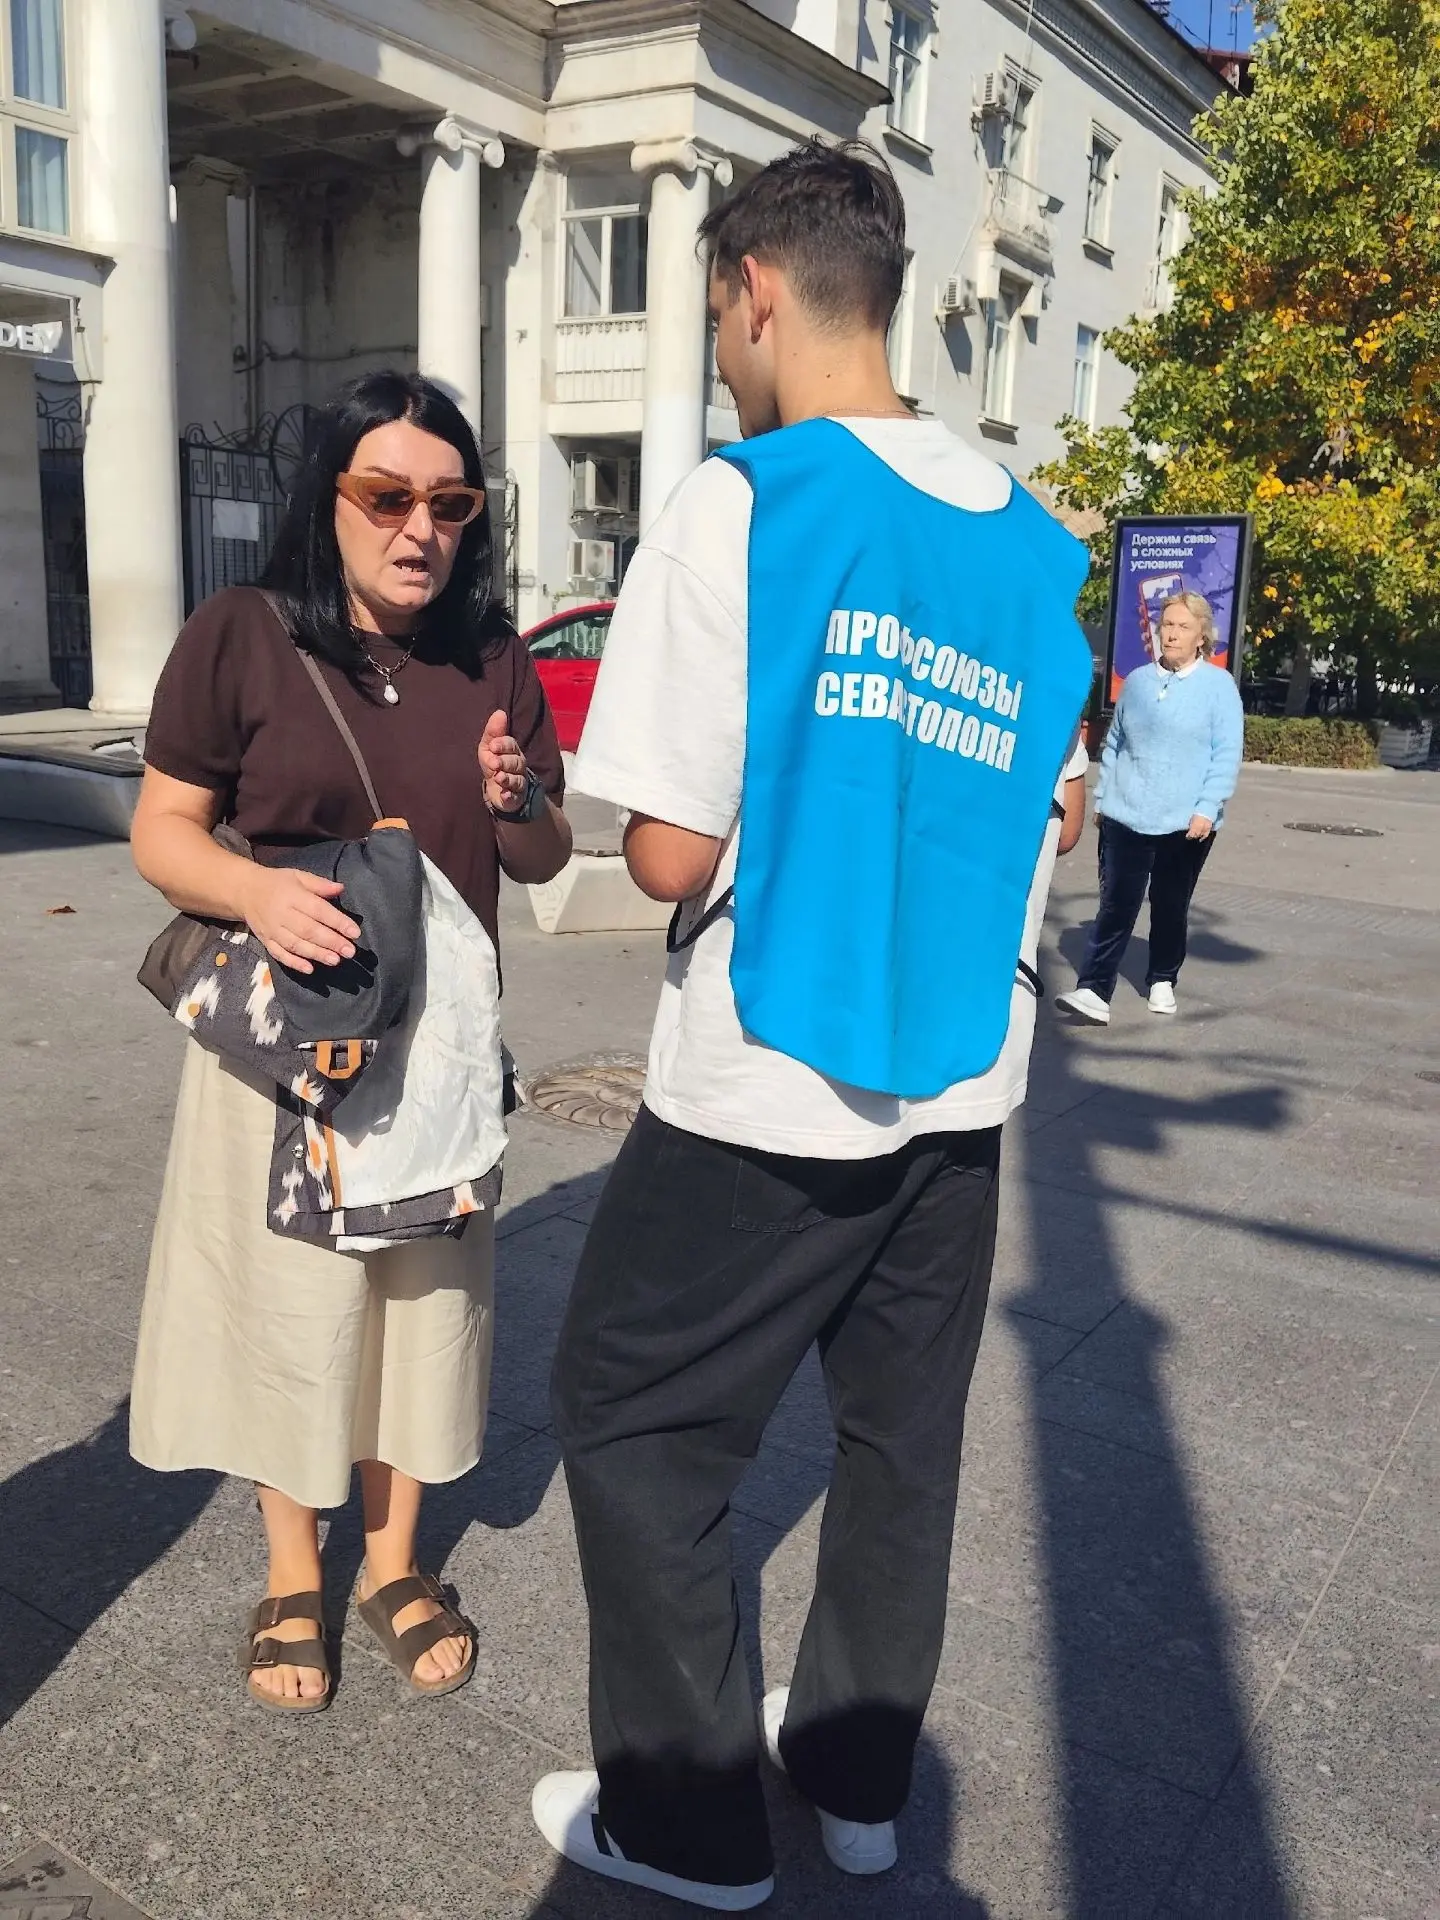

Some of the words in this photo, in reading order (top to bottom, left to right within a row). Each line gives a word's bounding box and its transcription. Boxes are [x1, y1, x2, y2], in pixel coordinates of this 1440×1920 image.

[1131, 533, 1181, 546] Держим
[1183, 535, 1217, 544] связь
[1131, 548, 1139, 557] в
[1141, 547, 1193, 557] сложных
[1130, 560, 1184, 572] условиях
